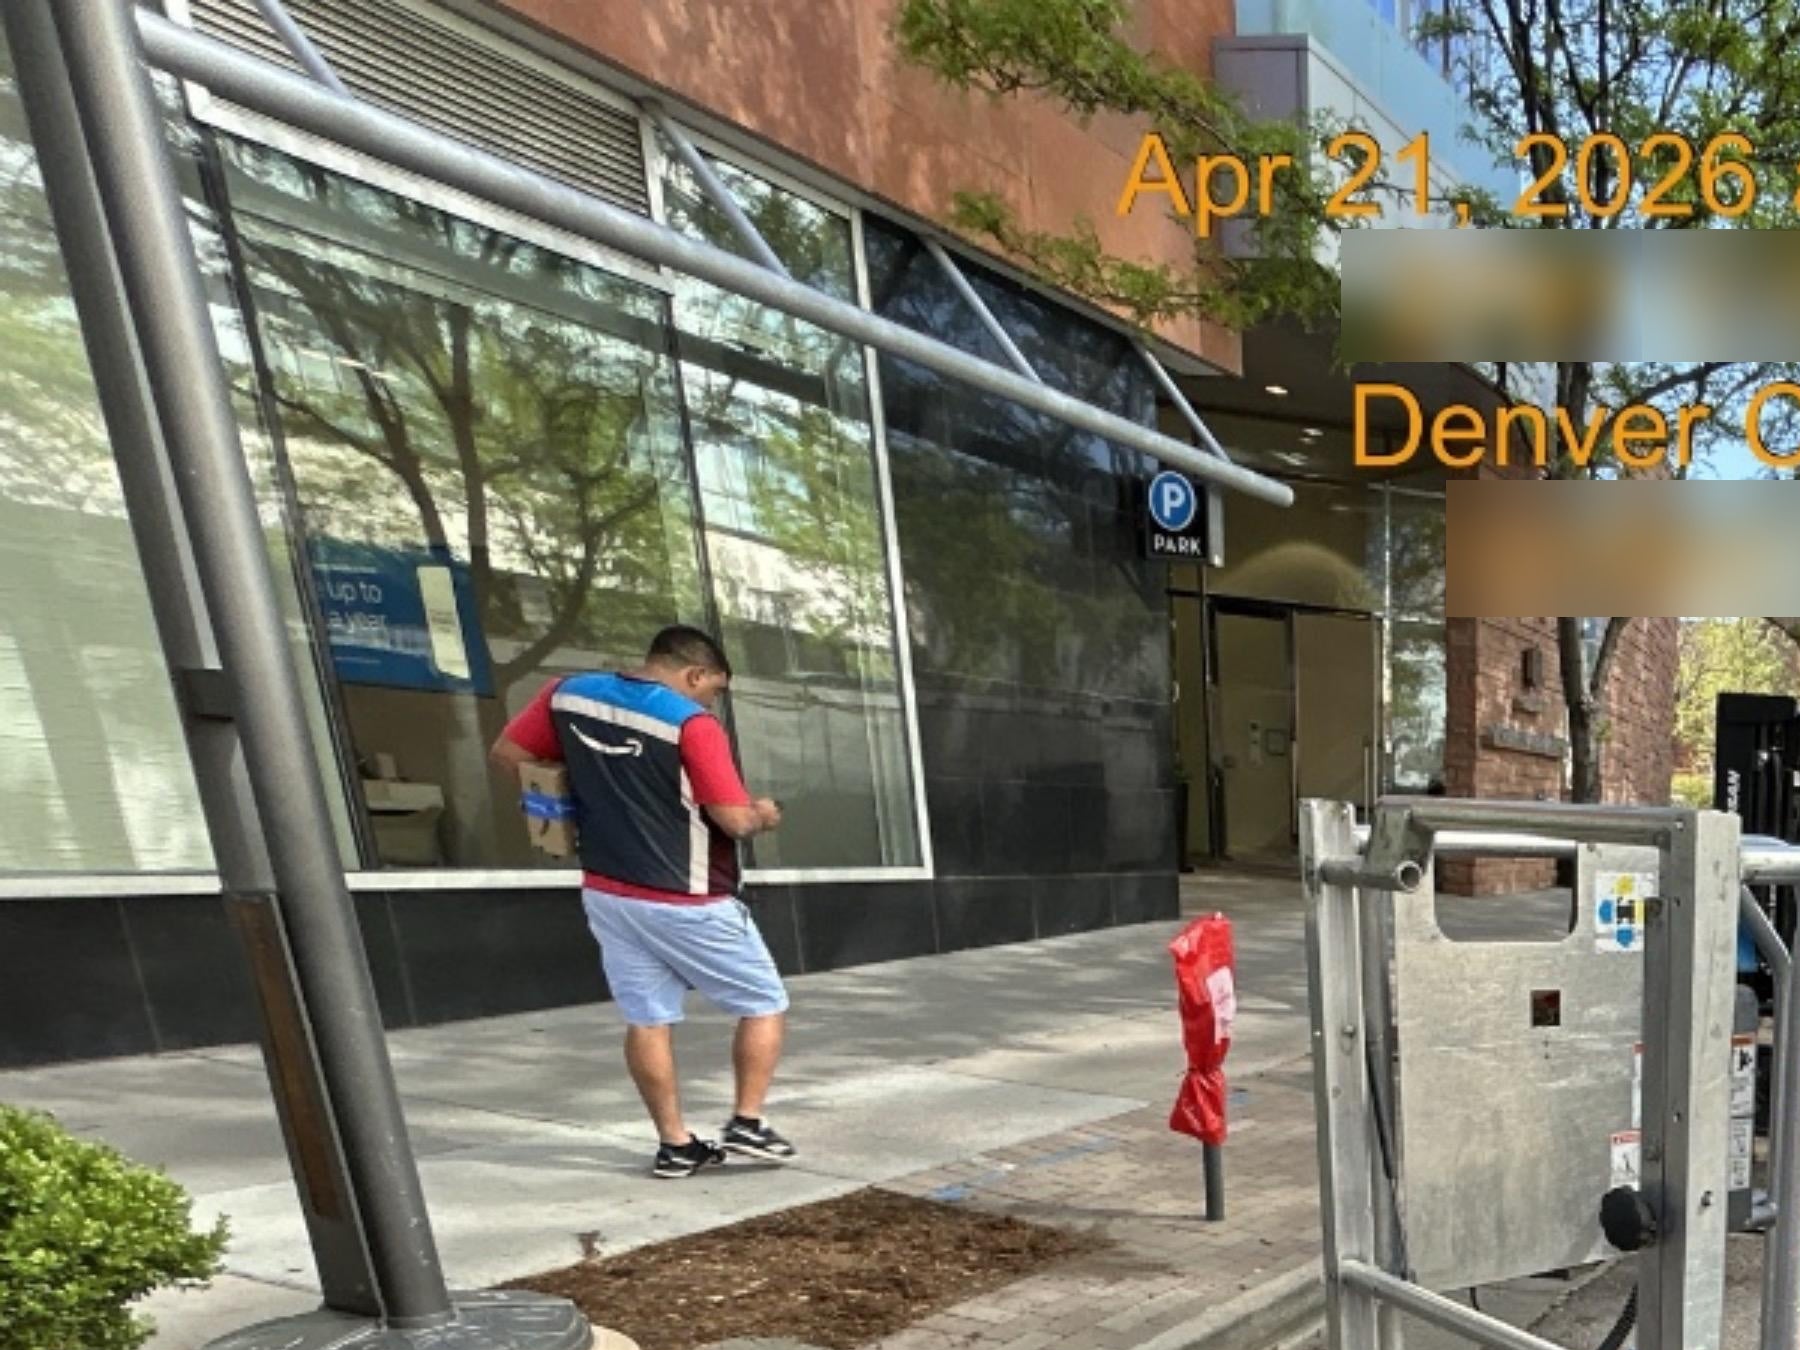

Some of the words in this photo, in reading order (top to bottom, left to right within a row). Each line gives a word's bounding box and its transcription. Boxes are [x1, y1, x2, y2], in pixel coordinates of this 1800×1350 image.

[1163, 482, 1186, 519] P
[1154, 533, 1202, 556] PARK
[360, 581, 382, 604] to
